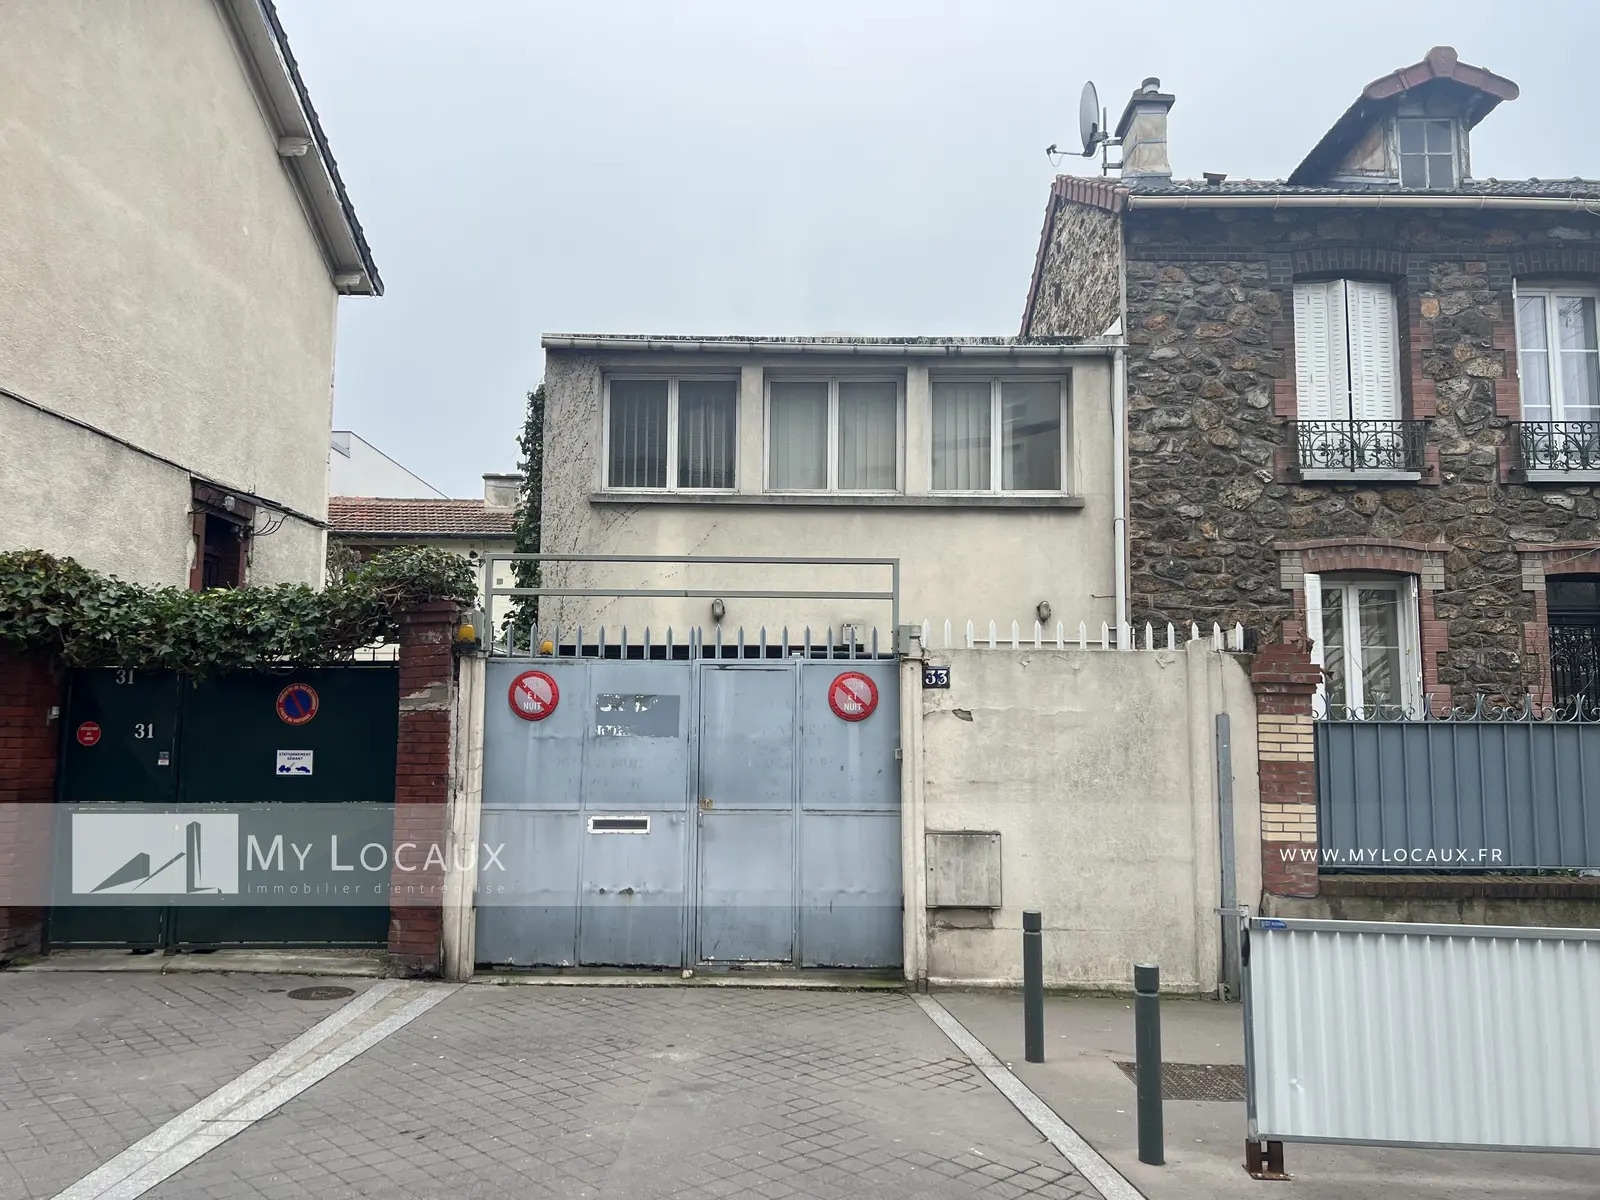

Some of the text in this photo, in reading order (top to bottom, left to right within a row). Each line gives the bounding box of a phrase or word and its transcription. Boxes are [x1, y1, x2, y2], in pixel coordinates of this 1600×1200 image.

[116, 669, 134, 684] 31
[925, 670, 948, 685] 33
[528, 691, 538, 699] ET
[523, 701, 542, 710] NUIT
[843, 702, 862, 711] NUIT
[134, 723, 154, 739] 31
